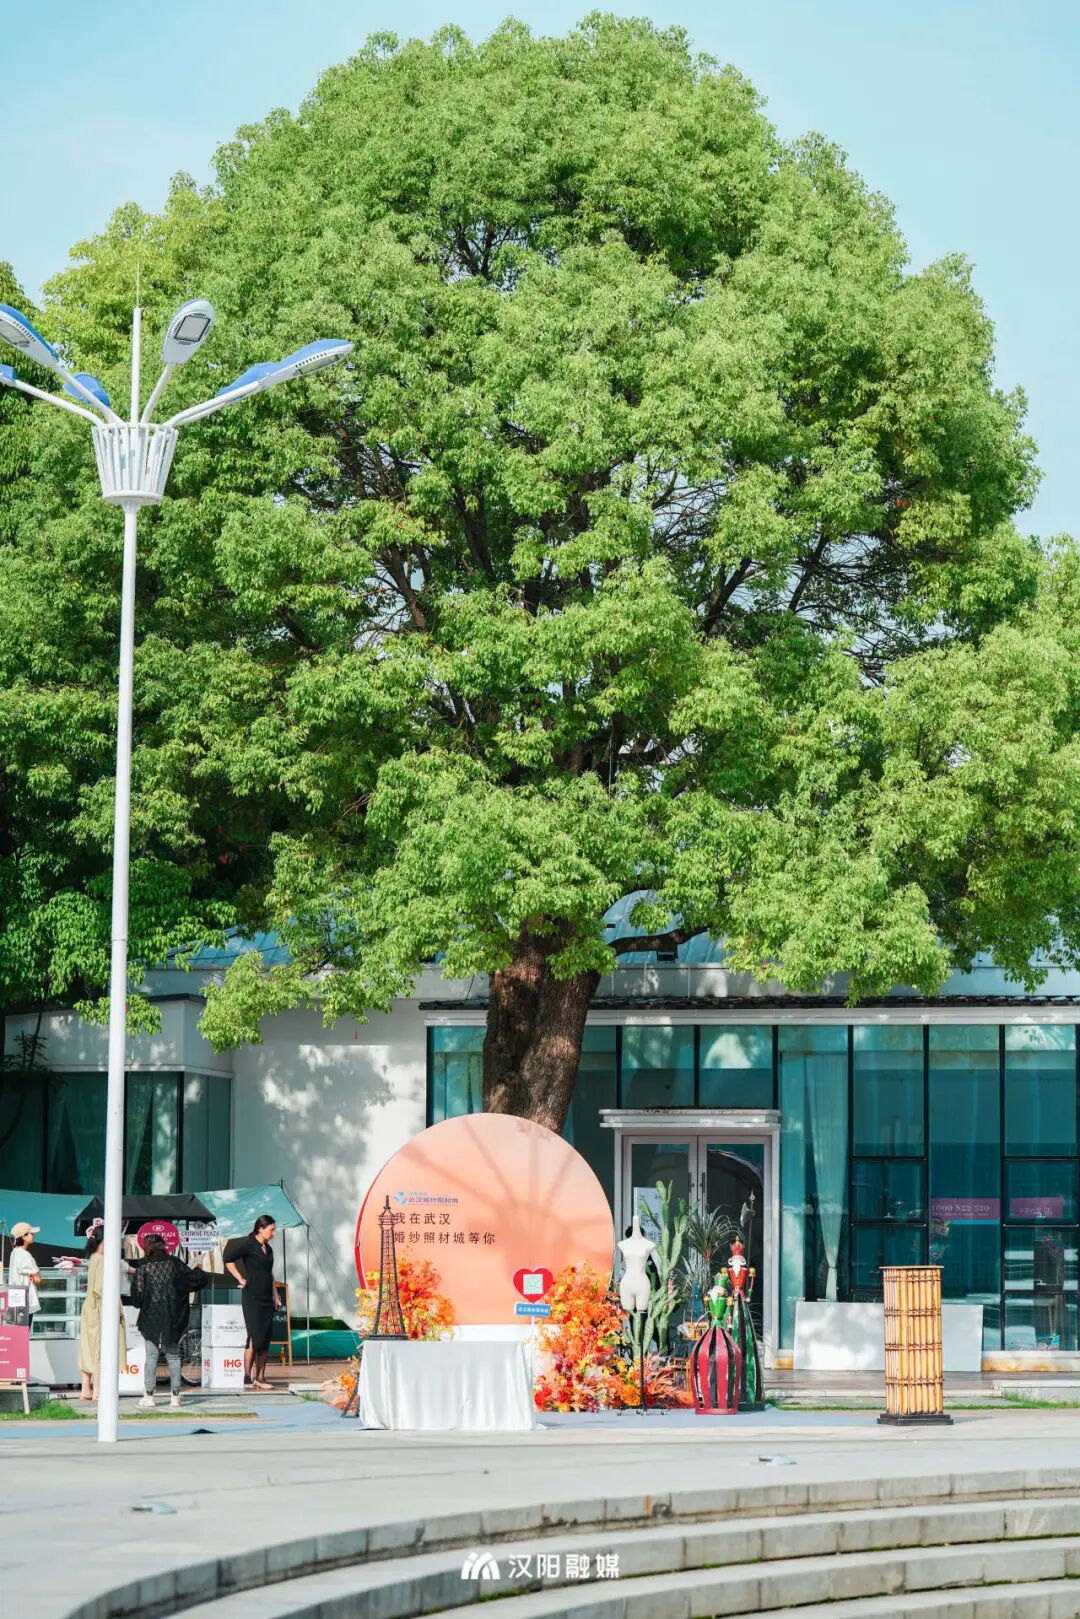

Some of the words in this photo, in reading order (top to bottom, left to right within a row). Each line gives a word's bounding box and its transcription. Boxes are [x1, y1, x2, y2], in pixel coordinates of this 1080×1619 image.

[394, 1212, 450, 1225] 我在武汉
[394, 1231, 495, 1245] 婚纱照材城等你
[121, 1364, 139, 1375] HG
[223, 1359, 242, 1368] IHG
